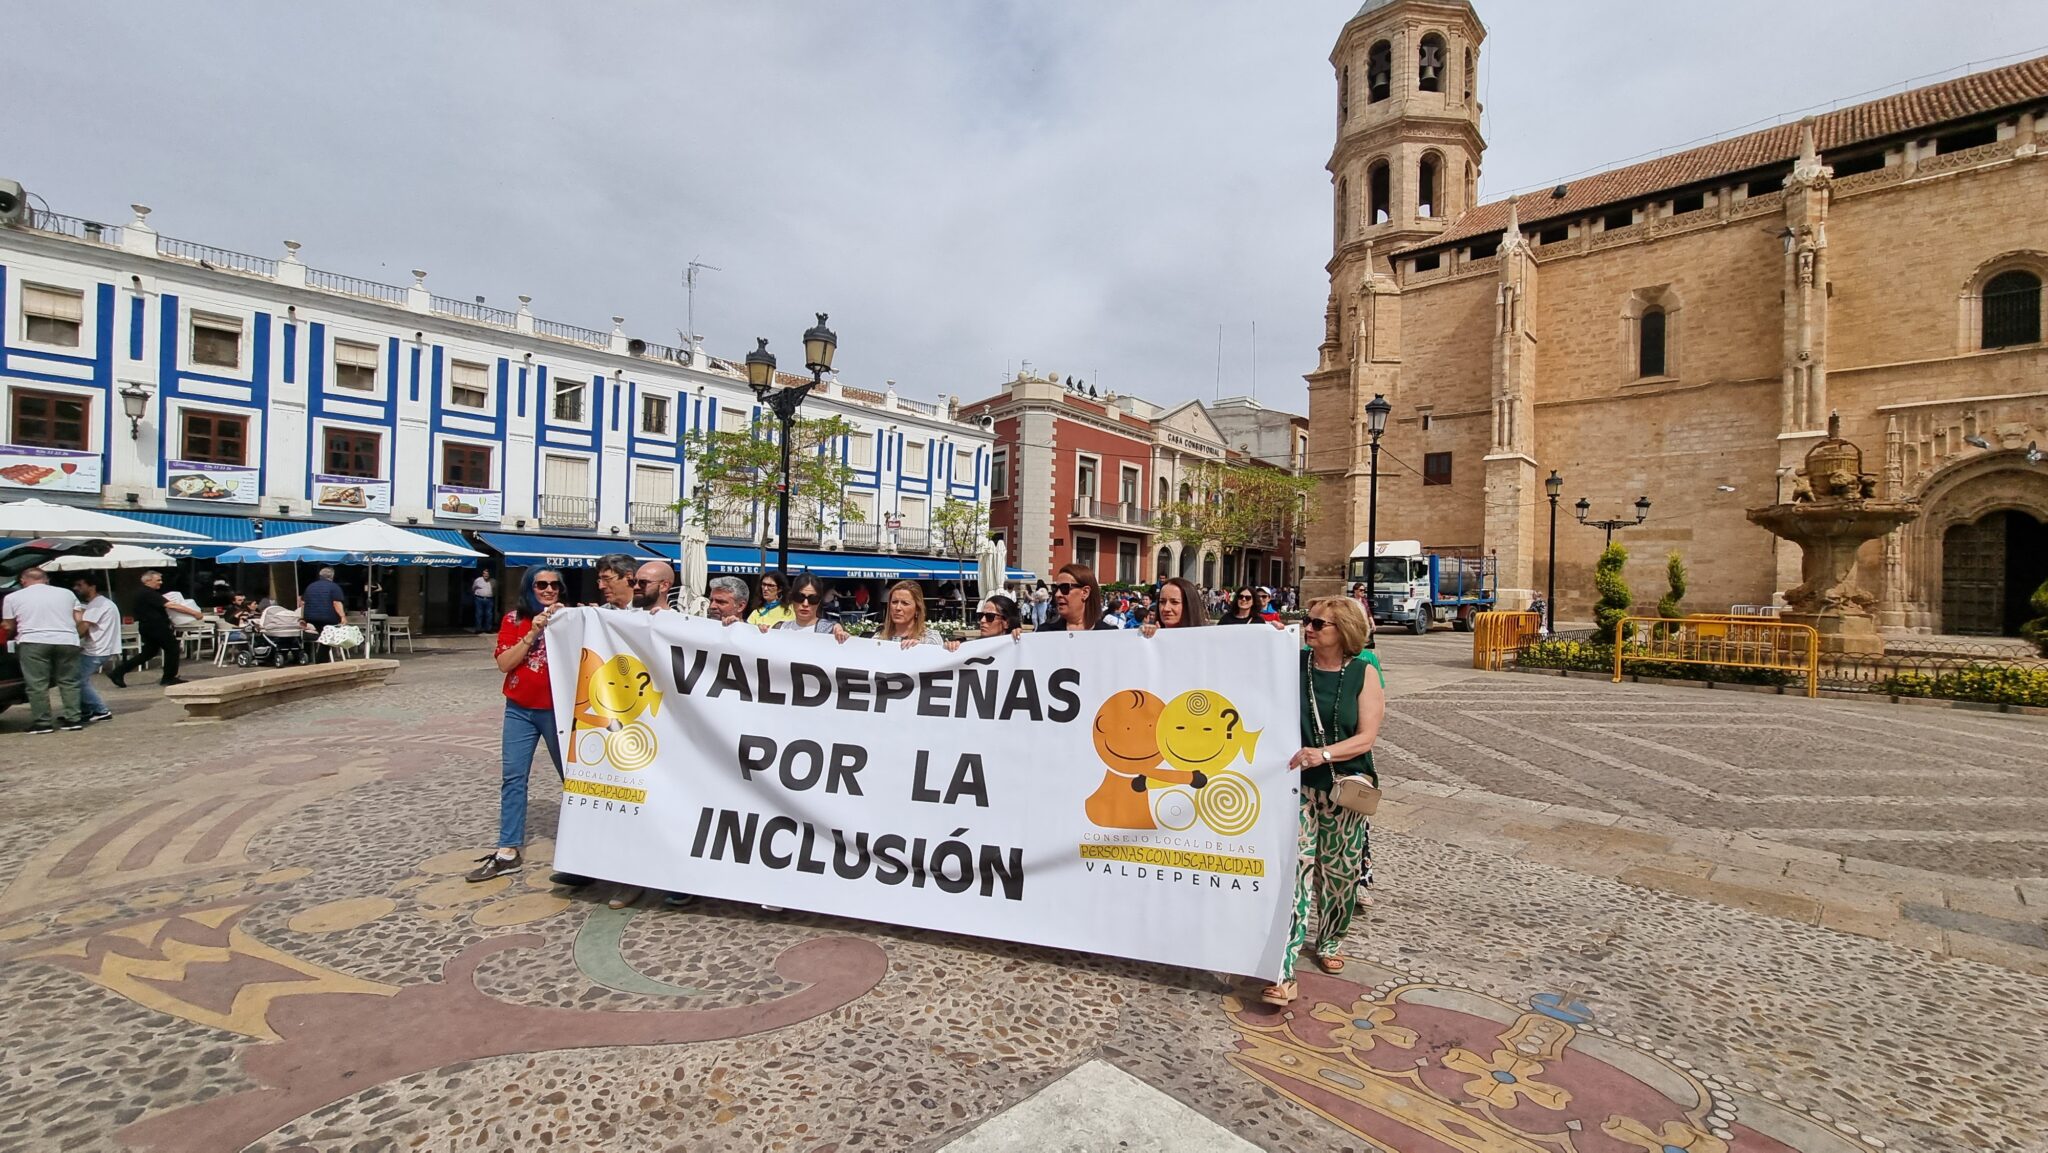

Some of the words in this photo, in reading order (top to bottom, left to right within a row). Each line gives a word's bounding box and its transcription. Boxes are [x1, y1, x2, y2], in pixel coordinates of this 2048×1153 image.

[1167, 433, 1183, 445] CASA
[1184, 439, 1220, 457] CONSISTORIAL
[411, 556, 462, 565] Baguettes
[720, 565, 761, 573] ENOTEC
[670, 645, 1081, 723] VALDEPEÑAS
[572, 769, 604, 780] LOCAL
[606, 774, 619, 783] DE
[623, 777, 645, 786] LAS
[738, 734, 868, 796] POR
[911, 750, 990, 808] LA
[581, 781, 646, 802] DISCAPACIDAD
[567, 795, 640, 816] EPEÑAS
[690, 807, 1024, 901] INCLUSIÓN
[1083, 832, 1149, 843] CONSEJO
[1155, 836, 1200, 848] LOCAL
[1205, 840, 1223, 851] DE
[1229, 843, 1256, 854] LAS
[1080, 845, 1144, 862] PERSONAS
[1145, 849, 1171, 866] CON
[1173, 851, 1263, 876] DISCAPACIDAD
[1086, 861, 1260, 892] VALDEPEÑAS
